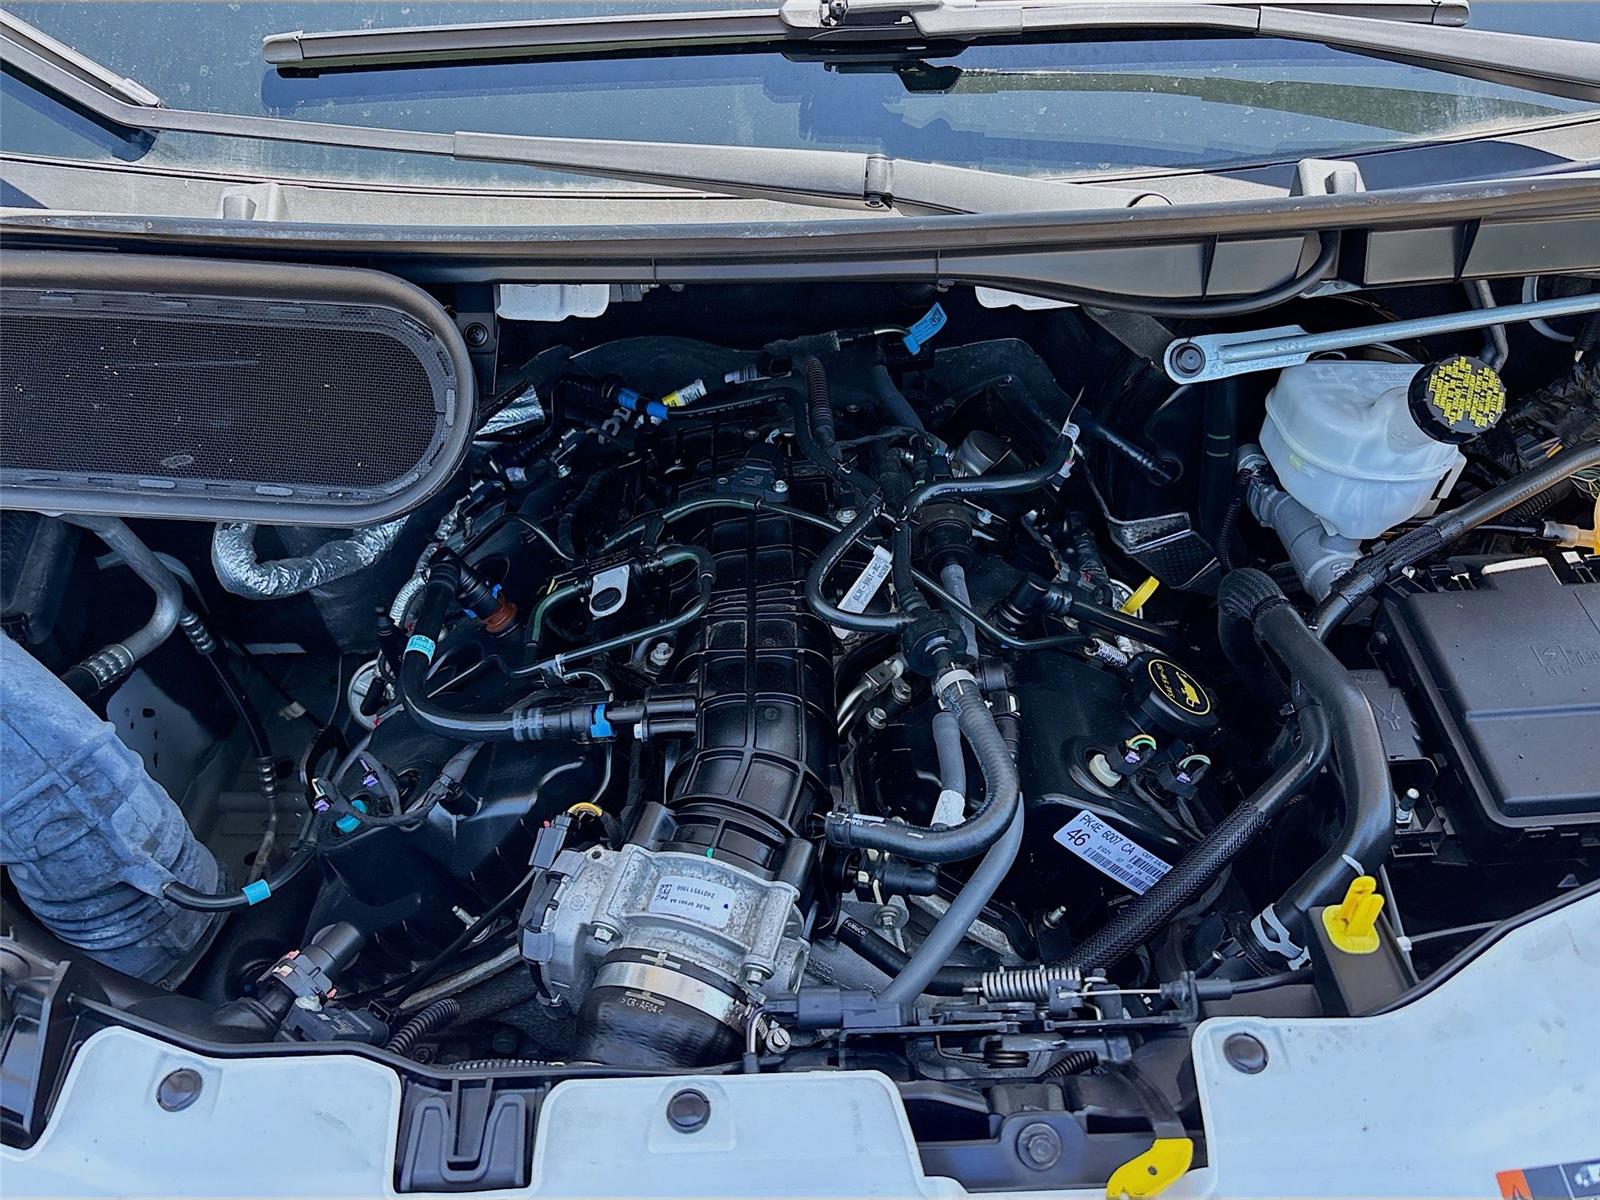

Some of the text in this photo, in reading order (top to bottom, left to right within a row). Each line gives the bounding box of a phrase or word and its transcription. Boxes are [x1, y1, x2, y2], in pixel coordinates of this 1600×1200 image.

[1066, 829, 1091, 846] 46
[1080, 814, 1136, 855] PK4E 6007 CA
